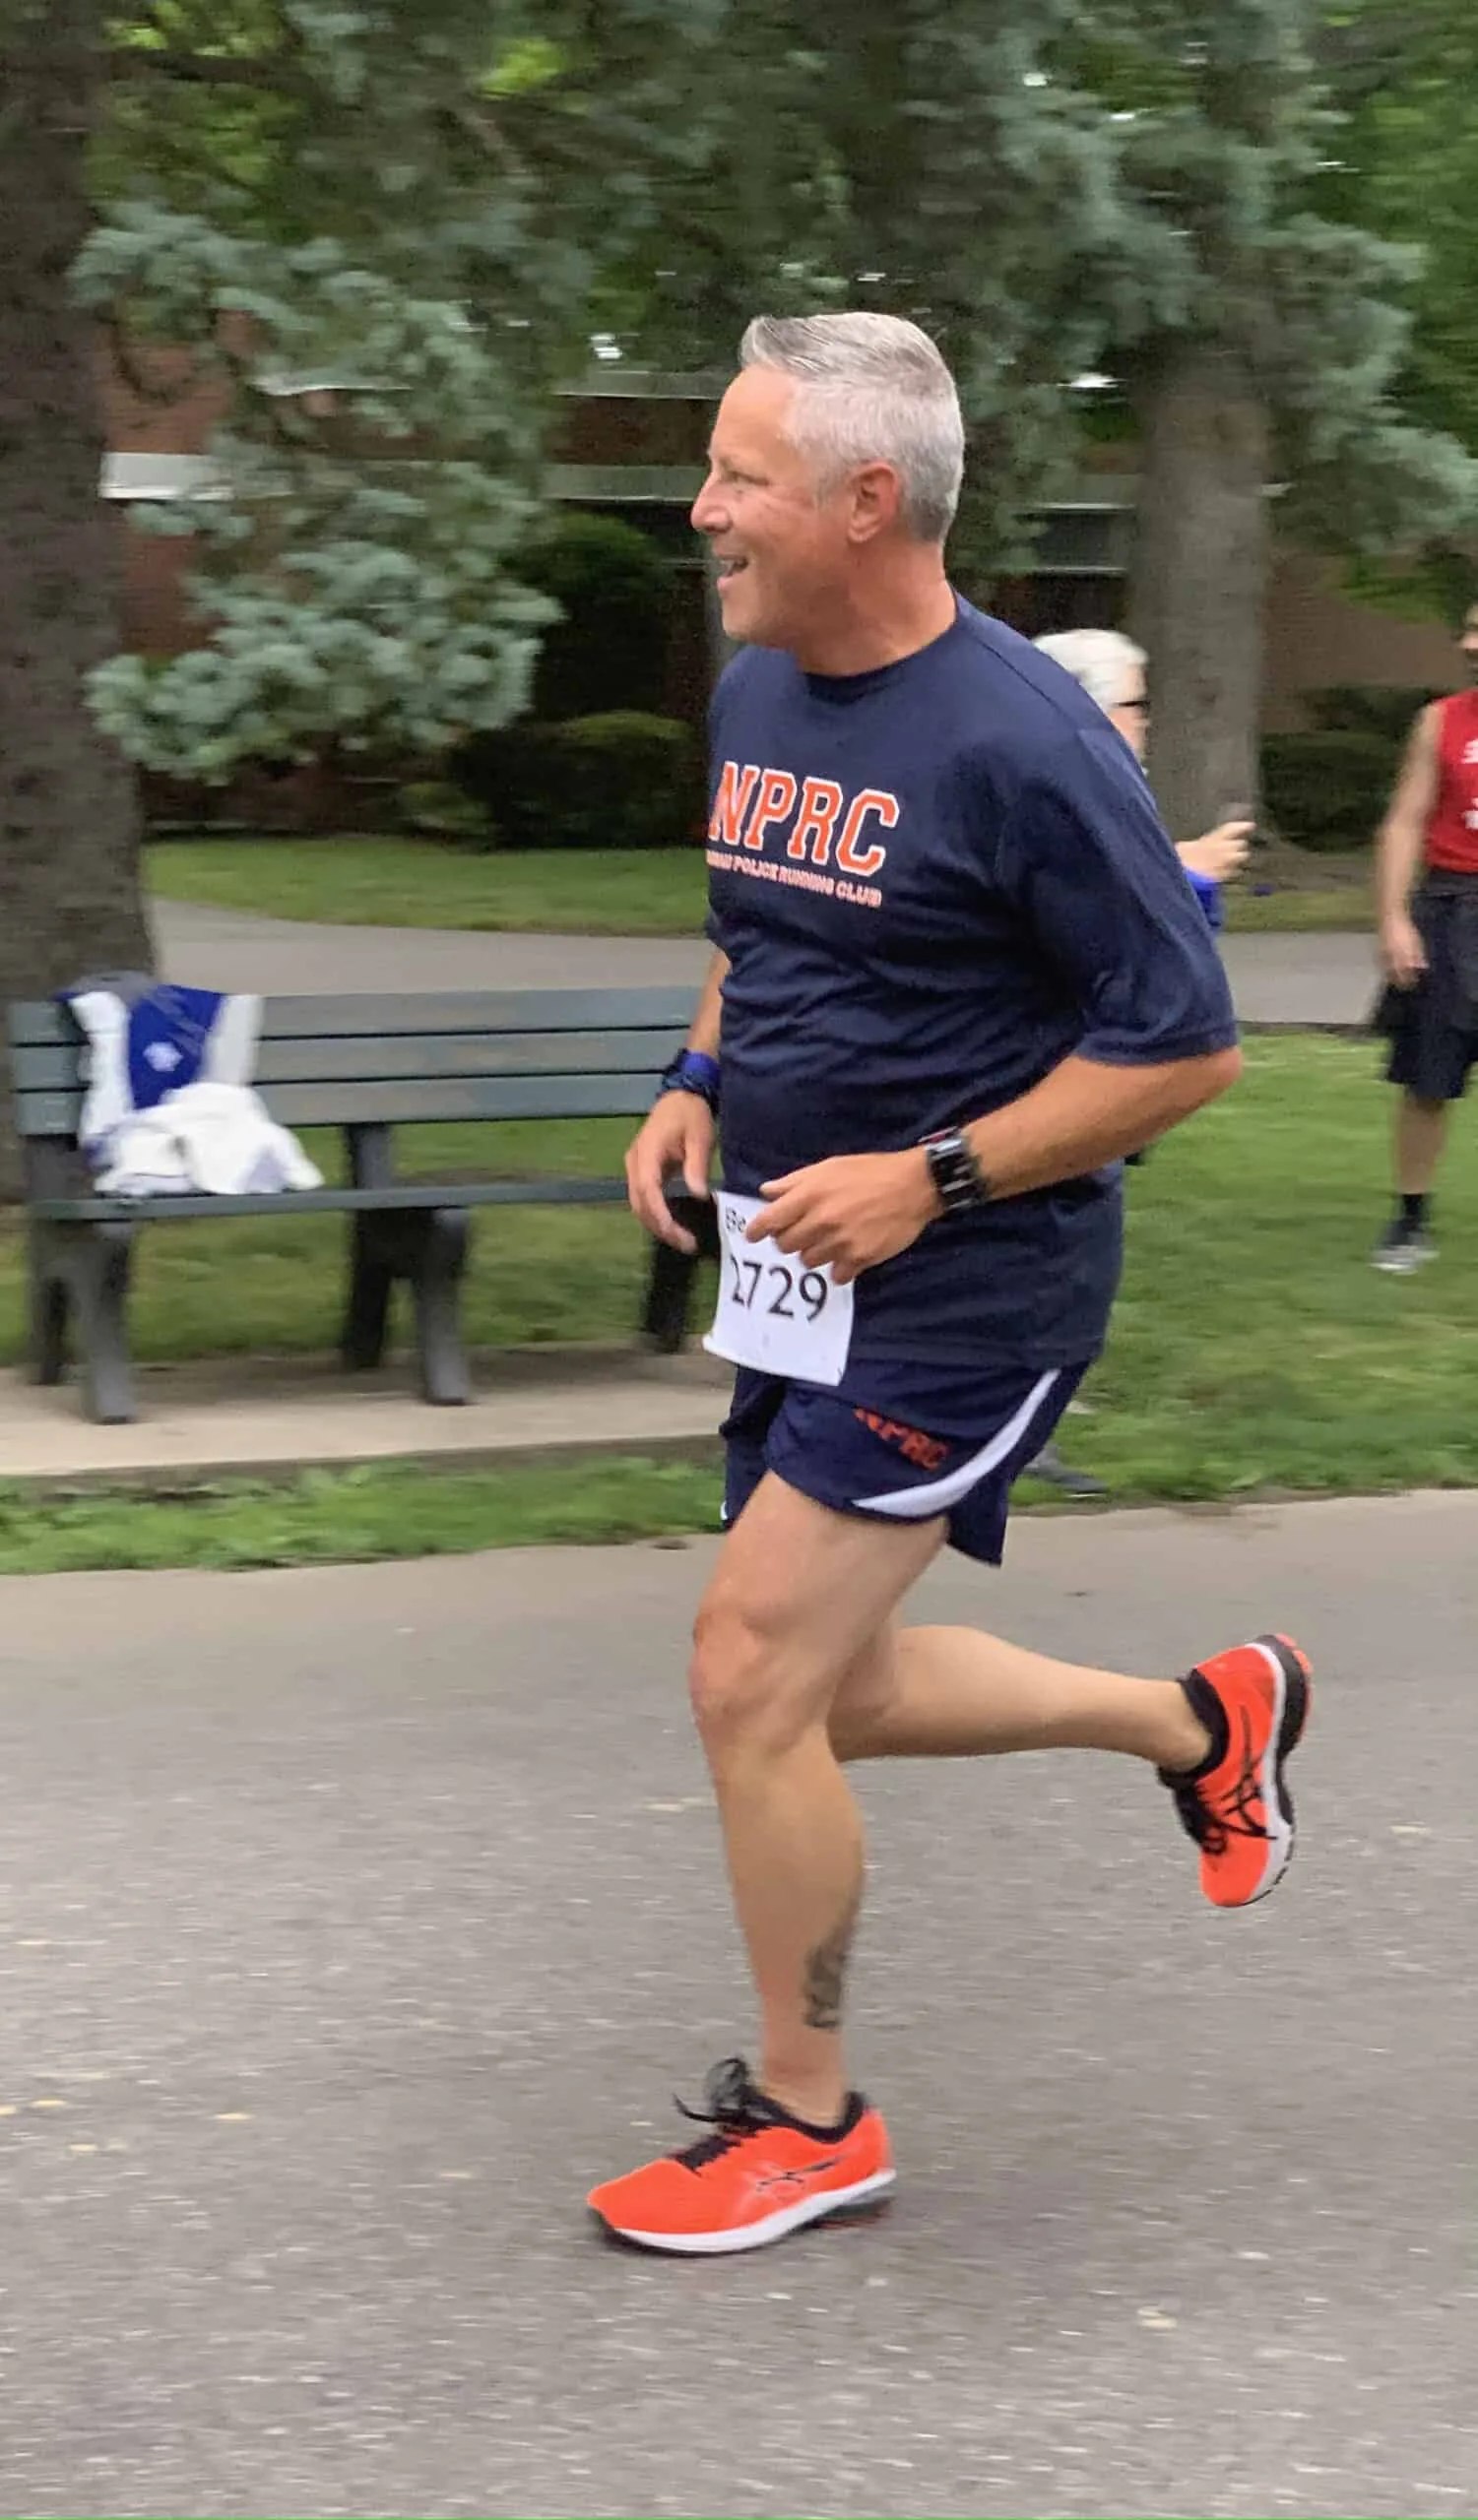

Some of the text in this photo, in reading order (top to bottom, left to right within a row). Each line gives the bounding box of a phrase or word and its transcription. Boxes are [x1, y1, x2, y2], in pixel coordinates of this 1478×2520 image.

[708, 760, 900, 877] NPRC
[733, 854, 779, 881] POLICE
[778, 865, 835, 896] RUNNING
[835, 880, 883, 908] CLUB
[730, 1253, 828, 1322] 2729
